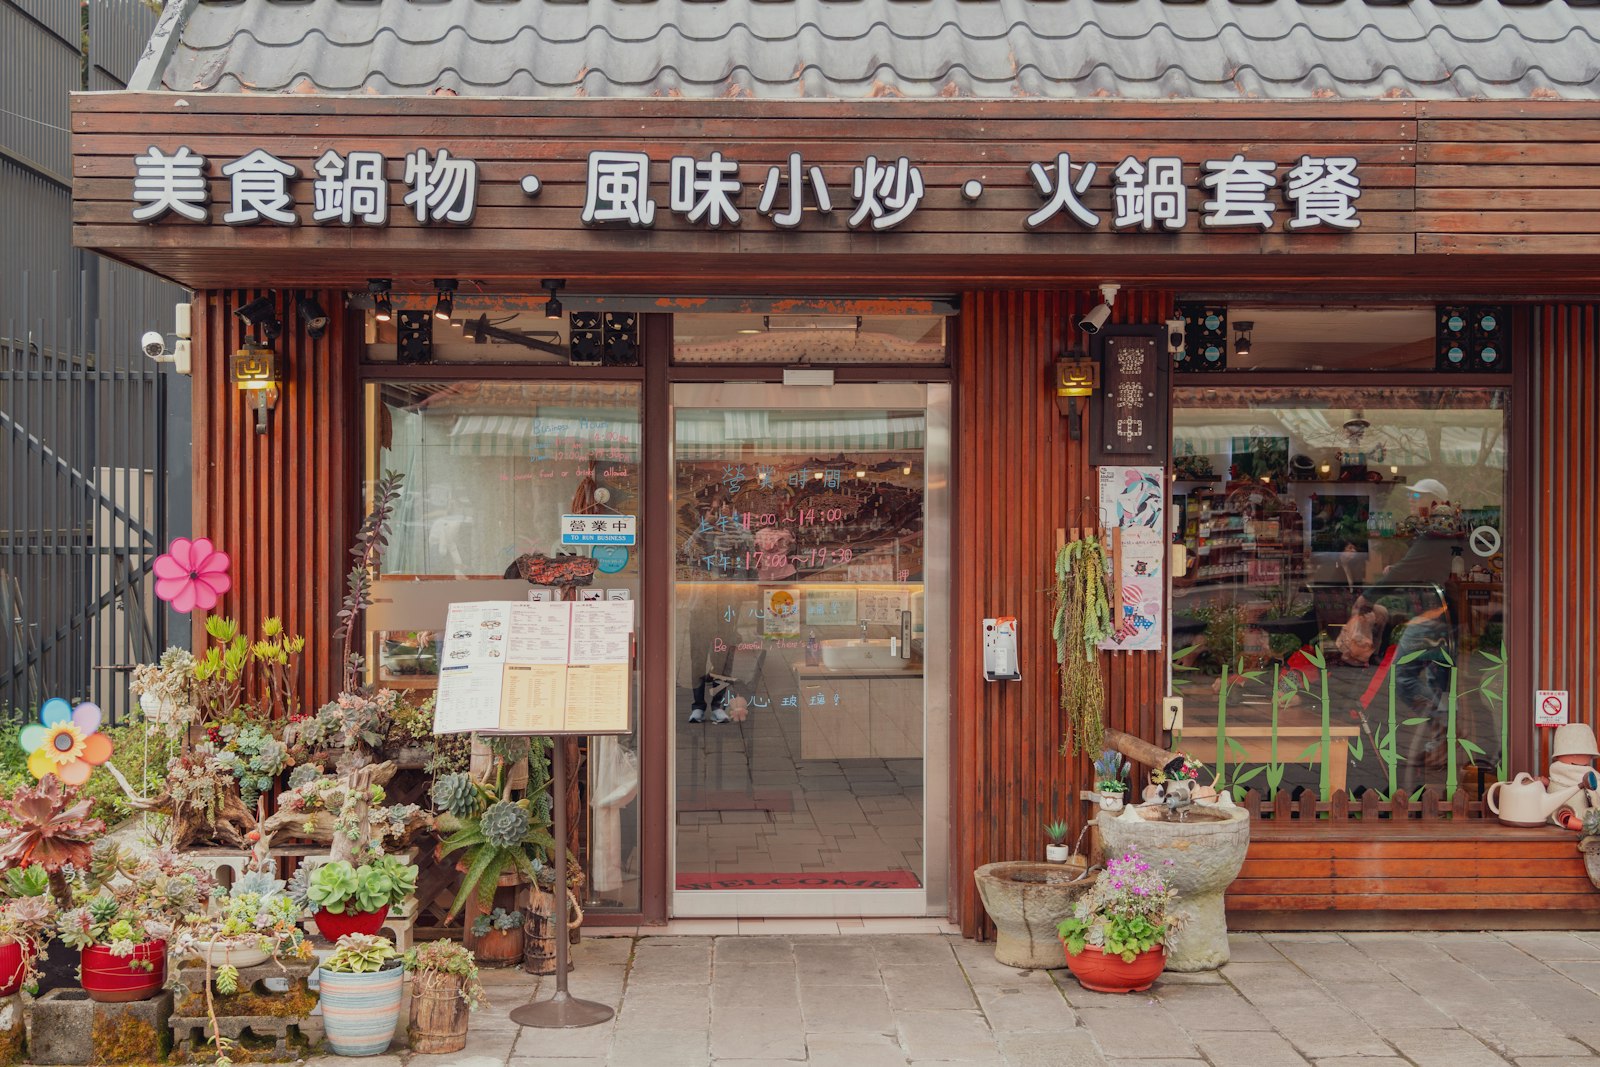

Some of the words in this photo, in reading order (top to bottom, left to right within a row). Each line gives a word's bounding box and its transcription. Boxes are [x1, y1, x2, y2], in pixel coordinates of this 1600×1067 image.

[132, 145, 478, 227] 美食鍋物
[581, 150, 924, 231] 風味小炒
[1024, 152, 1361, 231] 火鍋套餐
[1116, 346, 1145, 442] 營業中
[721, 463, 841, 493] 營業時間
[569, 520, 627, 532] 營業中
[714, 637, 727, 653] Be
[680, 877, 899, 889] WELCOME
